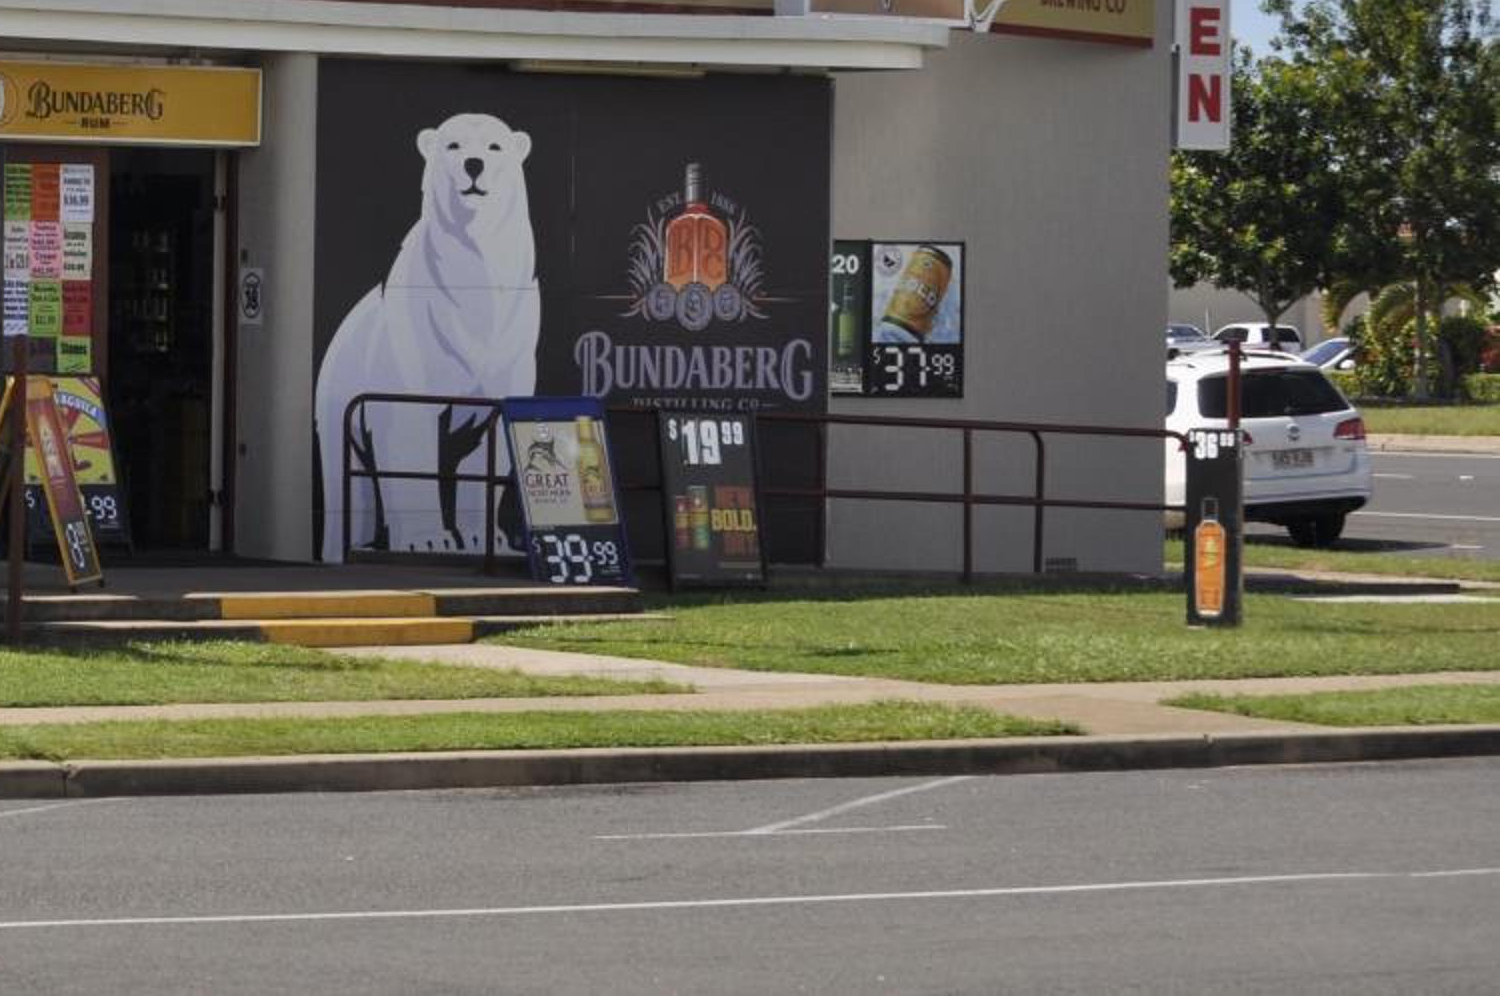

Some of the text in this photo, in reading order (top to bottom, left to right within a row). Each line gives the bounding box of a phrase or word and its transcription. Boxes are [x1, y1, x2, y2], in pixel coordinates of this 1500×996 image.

[26, 80, 167, 121] BUNDABERG
[80, 116, 111, 129] RUM
[574, 331, 814, 402] BUNDABERG
[525, 473, 570, 490] GREAT
